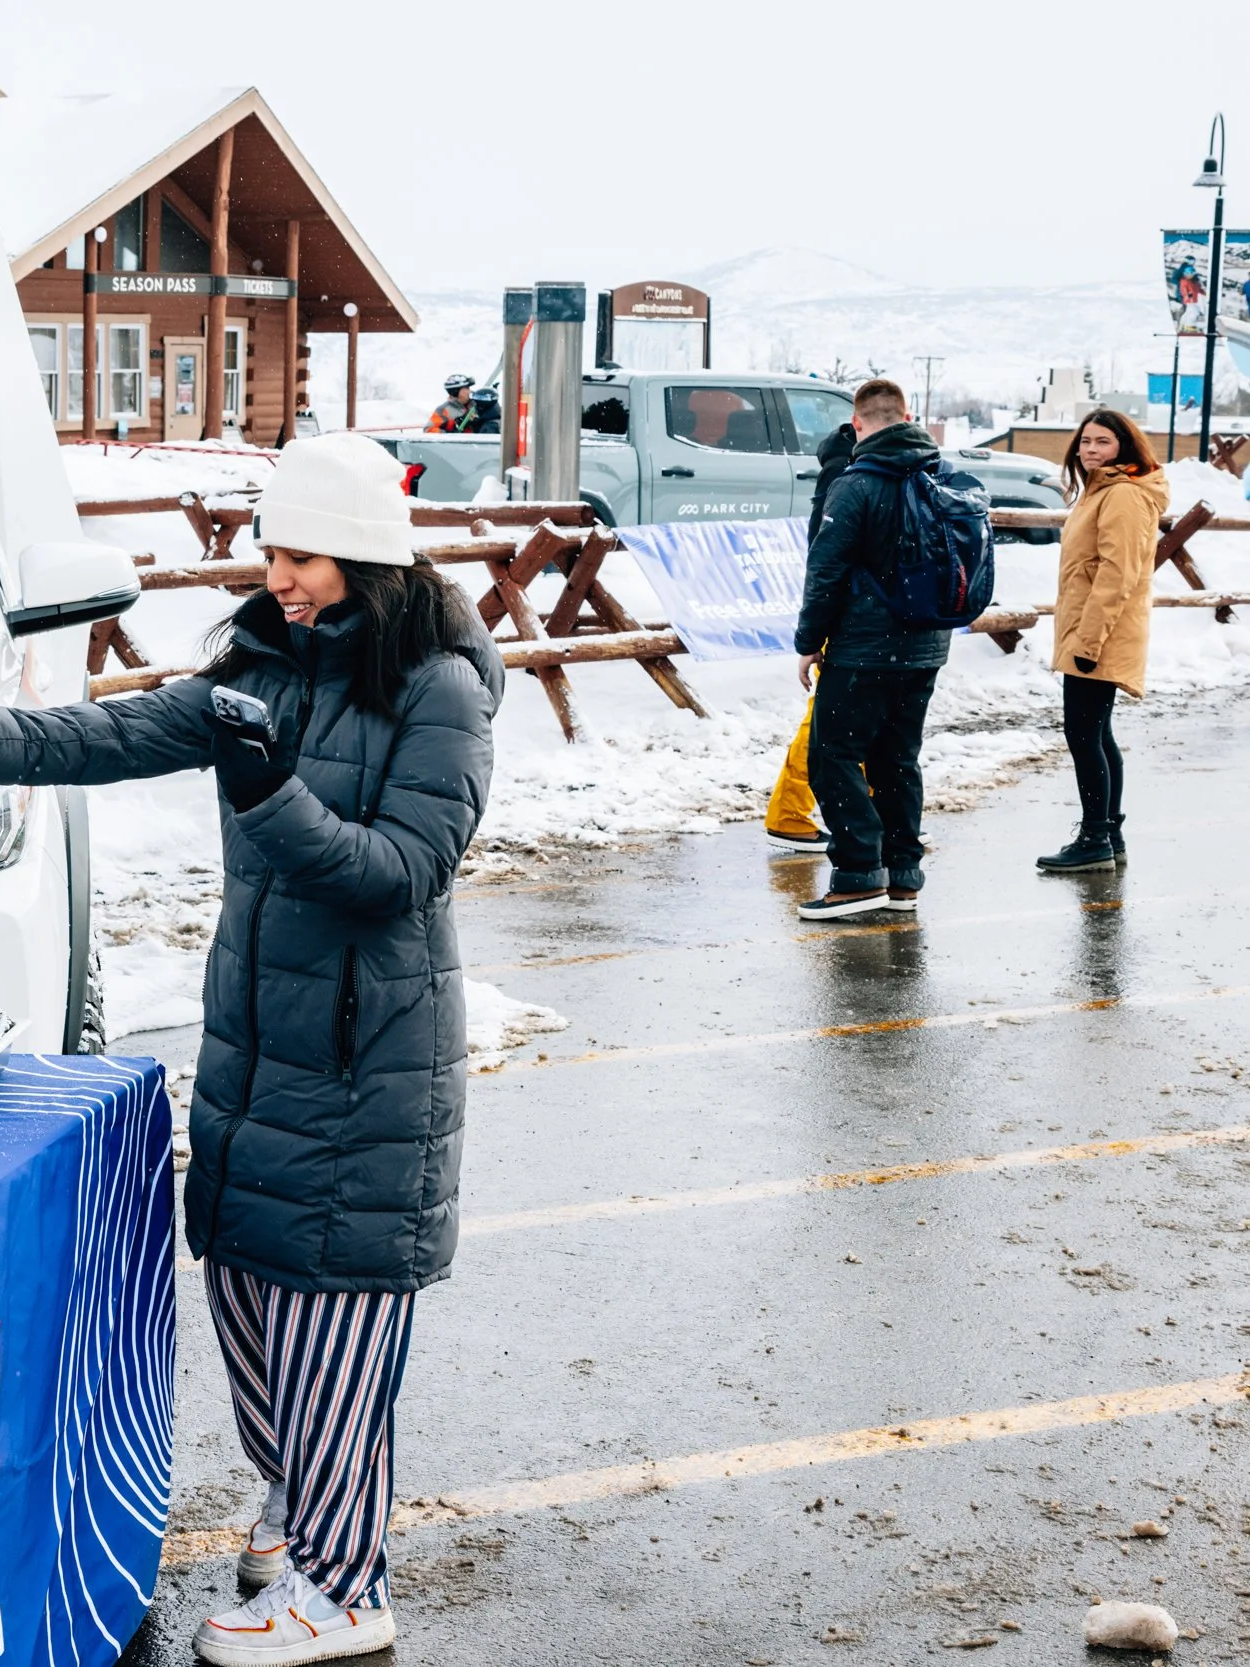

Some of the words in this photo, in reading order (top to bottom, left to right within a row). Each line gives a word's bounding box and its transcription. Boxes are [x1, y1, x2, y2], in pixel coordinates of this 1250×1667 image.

[112, 276, 164, 292] SEASON
[167, 278, 196, 293] PASS
[243, 280, 274, 295] TICKETS
[655, 287, 682, 301] CANYONS
[704, 504, 736, 515] PARK
[740, 503, 770, 514] CITY
[687, 599, 742, 619] Free
